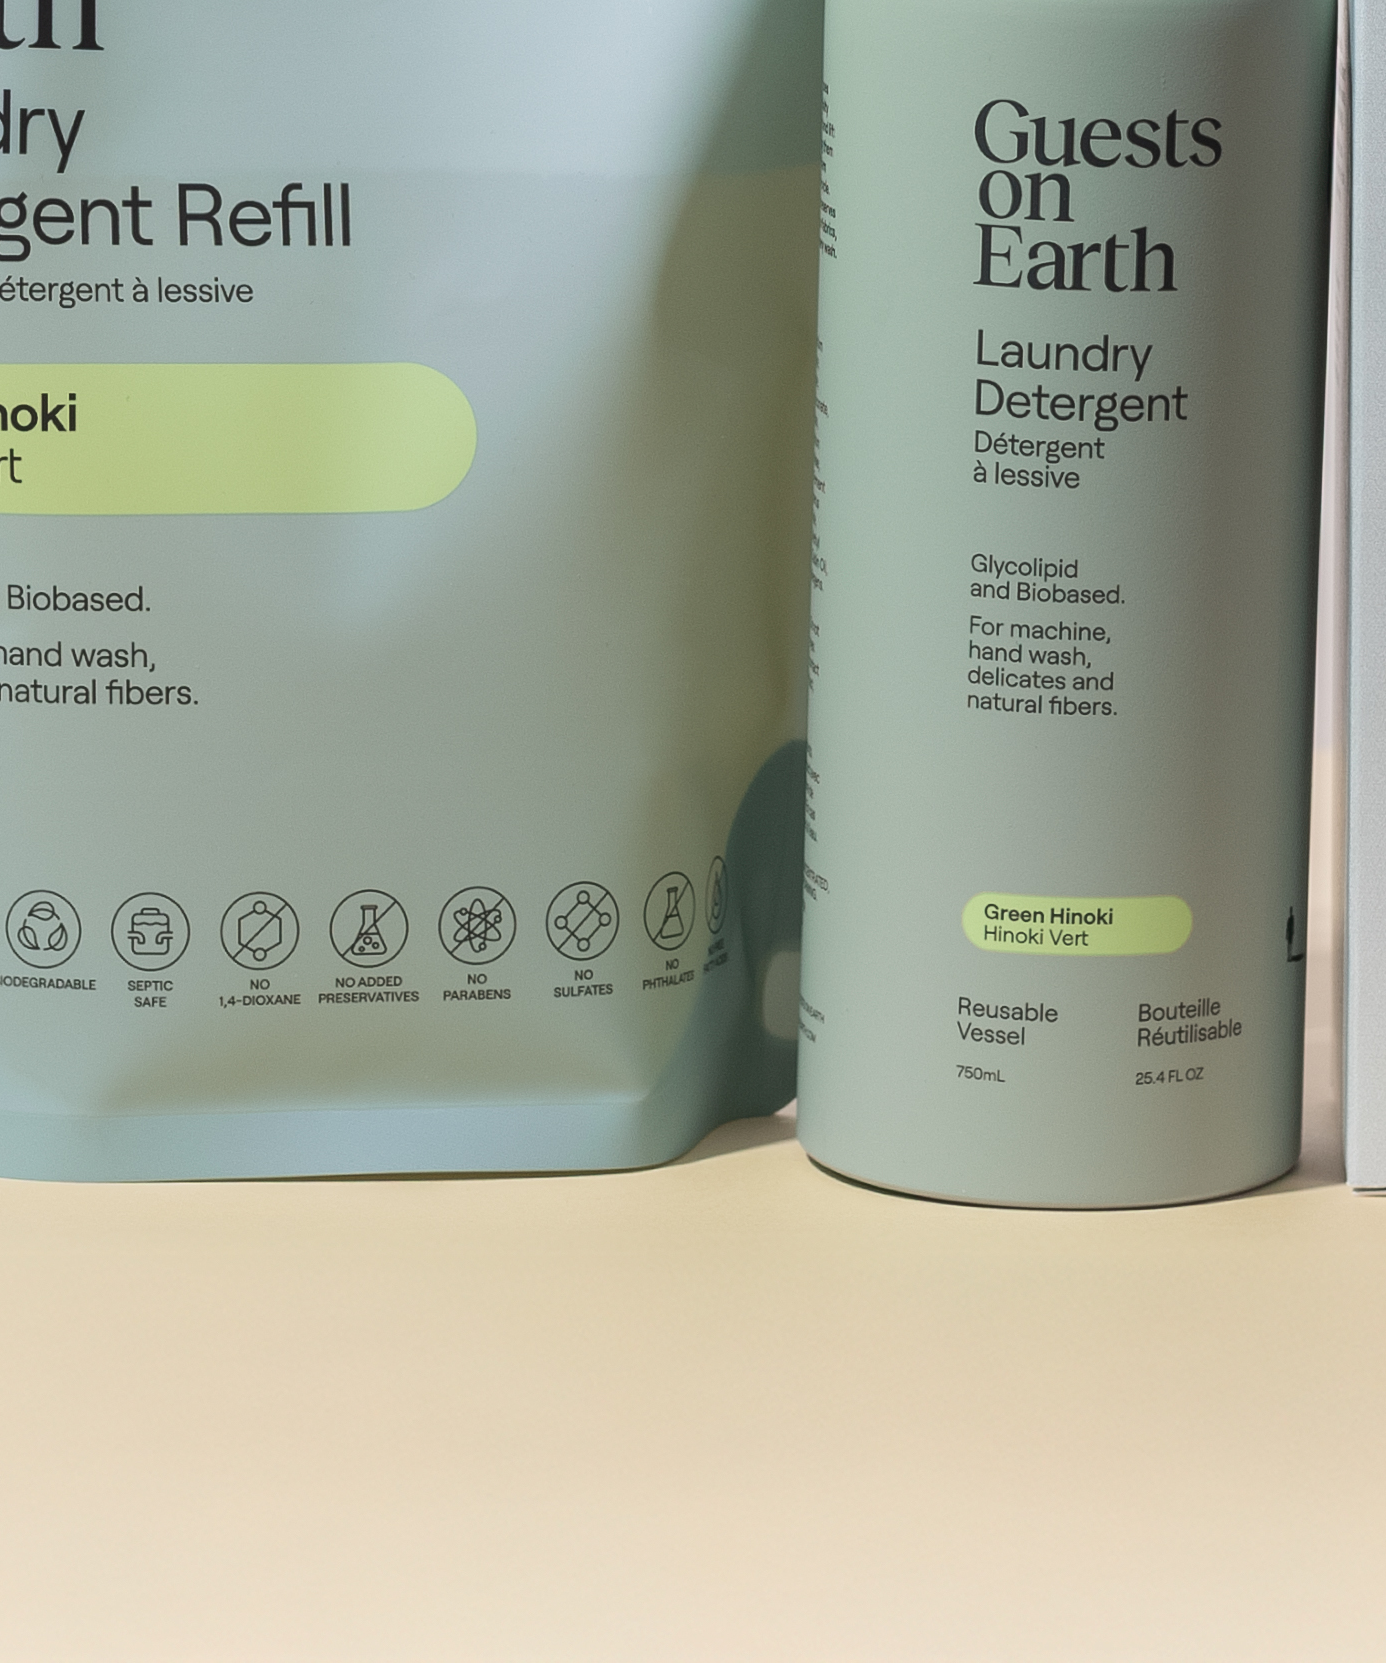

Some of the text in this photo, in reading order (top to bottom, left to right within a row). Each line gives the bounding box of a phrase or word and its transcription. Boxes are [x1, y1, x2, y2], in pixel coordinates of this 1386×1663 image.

[974, 99, 1223, 171] Guests
[978, 169, 1075, 223] on
[178, 182, 351, 247] Refill
[973, 222, 1179, 293] Earth
[132, 276, 149, 303] à
[158, 276, 254, 303] lessive
[977, 329, 1154, 383] Laundry
[975, 378, 1189, 432] Detergent
[974, 429, 1106, 464] Détergent
[973, 459, 1080, 489] à lessive
[971, 553, 1079, 583] Glycolipid
[7, 584, 151, 612] Biobased.
[970, 580, 1126, 605] and Biobased.
[969, 614, 1111, 645] For machine,
[71, 641, 156, 673] wash,
[969, 639, 1092, 669] hand wash,
[967, 665, 1114, 691] delicates and
[105, 678, 199, 706] fibers.
[967, 692, 1118, 716] natural fibers.
[984, 903, 1114, 925] Green Hinoki
[984, 924, 1089, 947] Hinoki Vert
[574, 968, 594, 981] NO
[665, 958, 680, 971] NO
[127, 979, 174, 992] SEPTIC
[249, 978, 271, 990] NO
[335, 975, 403, 988] NO ADDED
[467, 973, 488, 985] NO
[553, 983, 614, 998] SULFATES
[642, 969, 695, 990] PHTHALATES
[134, 996, 167, 1008] SAFE
[219, 993, 301, 1009] 1,4-DIOXANE
[318, 990, 420, 1004] PRESERVATIVES
[443, 988, 512, 1001] PARABENS
[958, 996, 1059, 1023] Reusable
[1138, 997, 1221, 1023] Bouteille
[956, 1020, 1026, 1046] Vessel
[1137, 1018, 1243, 1047] Réutilisable
[956, 1064, 1006, 1083] 750mL
[1135, 1066, 1205, 1086] 25.4 FL OZ
